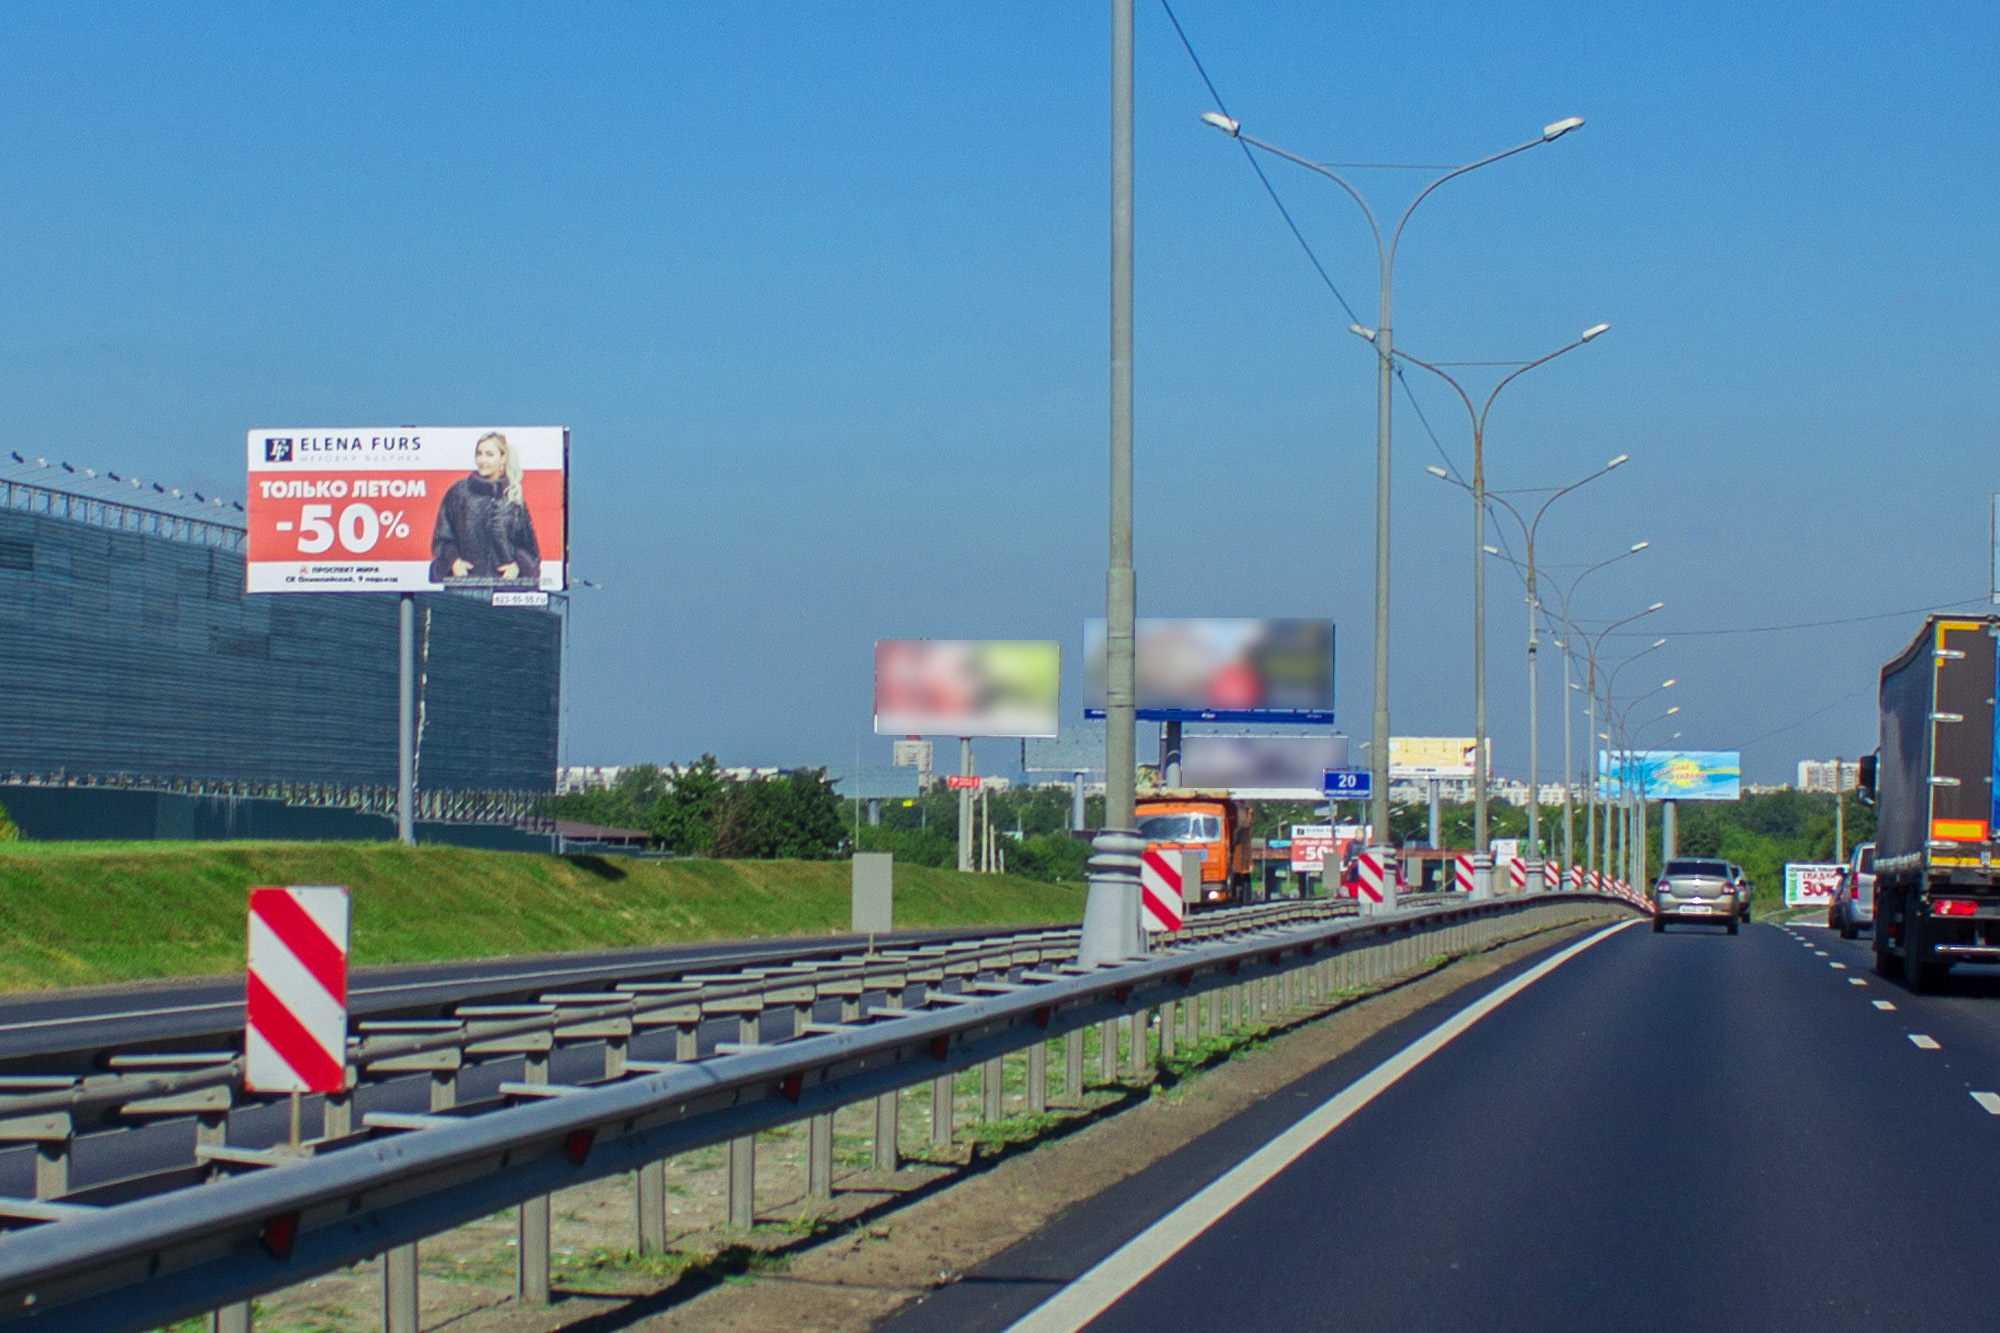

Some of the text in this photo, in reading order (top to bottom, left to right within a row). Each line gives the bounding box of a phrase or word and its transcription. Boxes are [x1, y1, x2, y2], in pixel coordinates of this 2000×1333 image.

[300, 437, 421, 451] ELENA FURS
[259, 480, 426, 499] ТОЛЬКО ЛЕТОМ
[276, 503, 410, 553] -50%
[1338, 775, 1357, 788] 20
